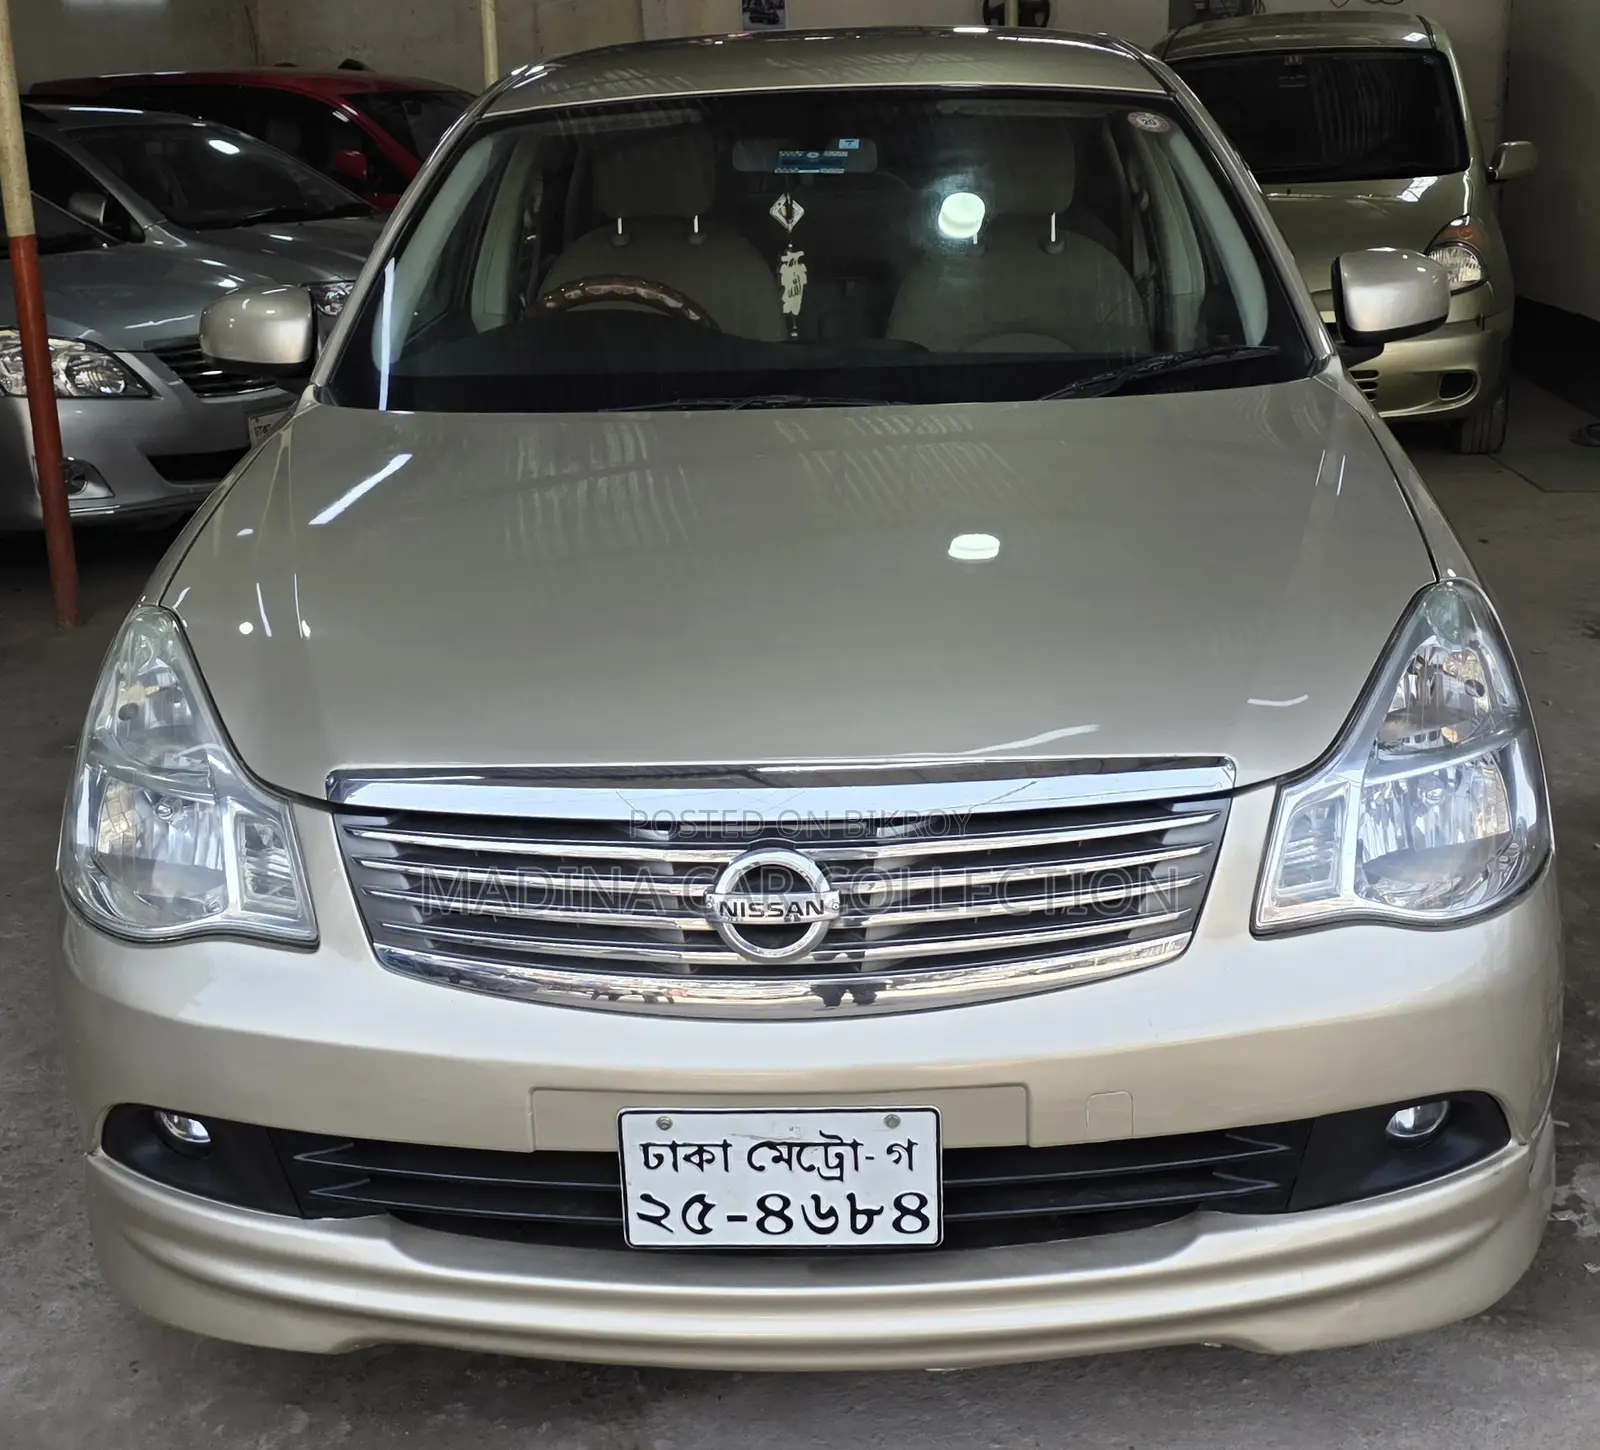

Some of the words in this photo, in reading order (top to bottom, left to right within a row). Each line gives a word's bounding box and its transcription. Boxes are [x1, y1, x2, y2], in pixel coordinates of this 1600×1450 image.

[719, 899, 826, 919] NISSAN
[640, 1139, 732, 1173] ঢাকা
[636, 1193, 930, 1235] ২৫-৪৬৮৪
